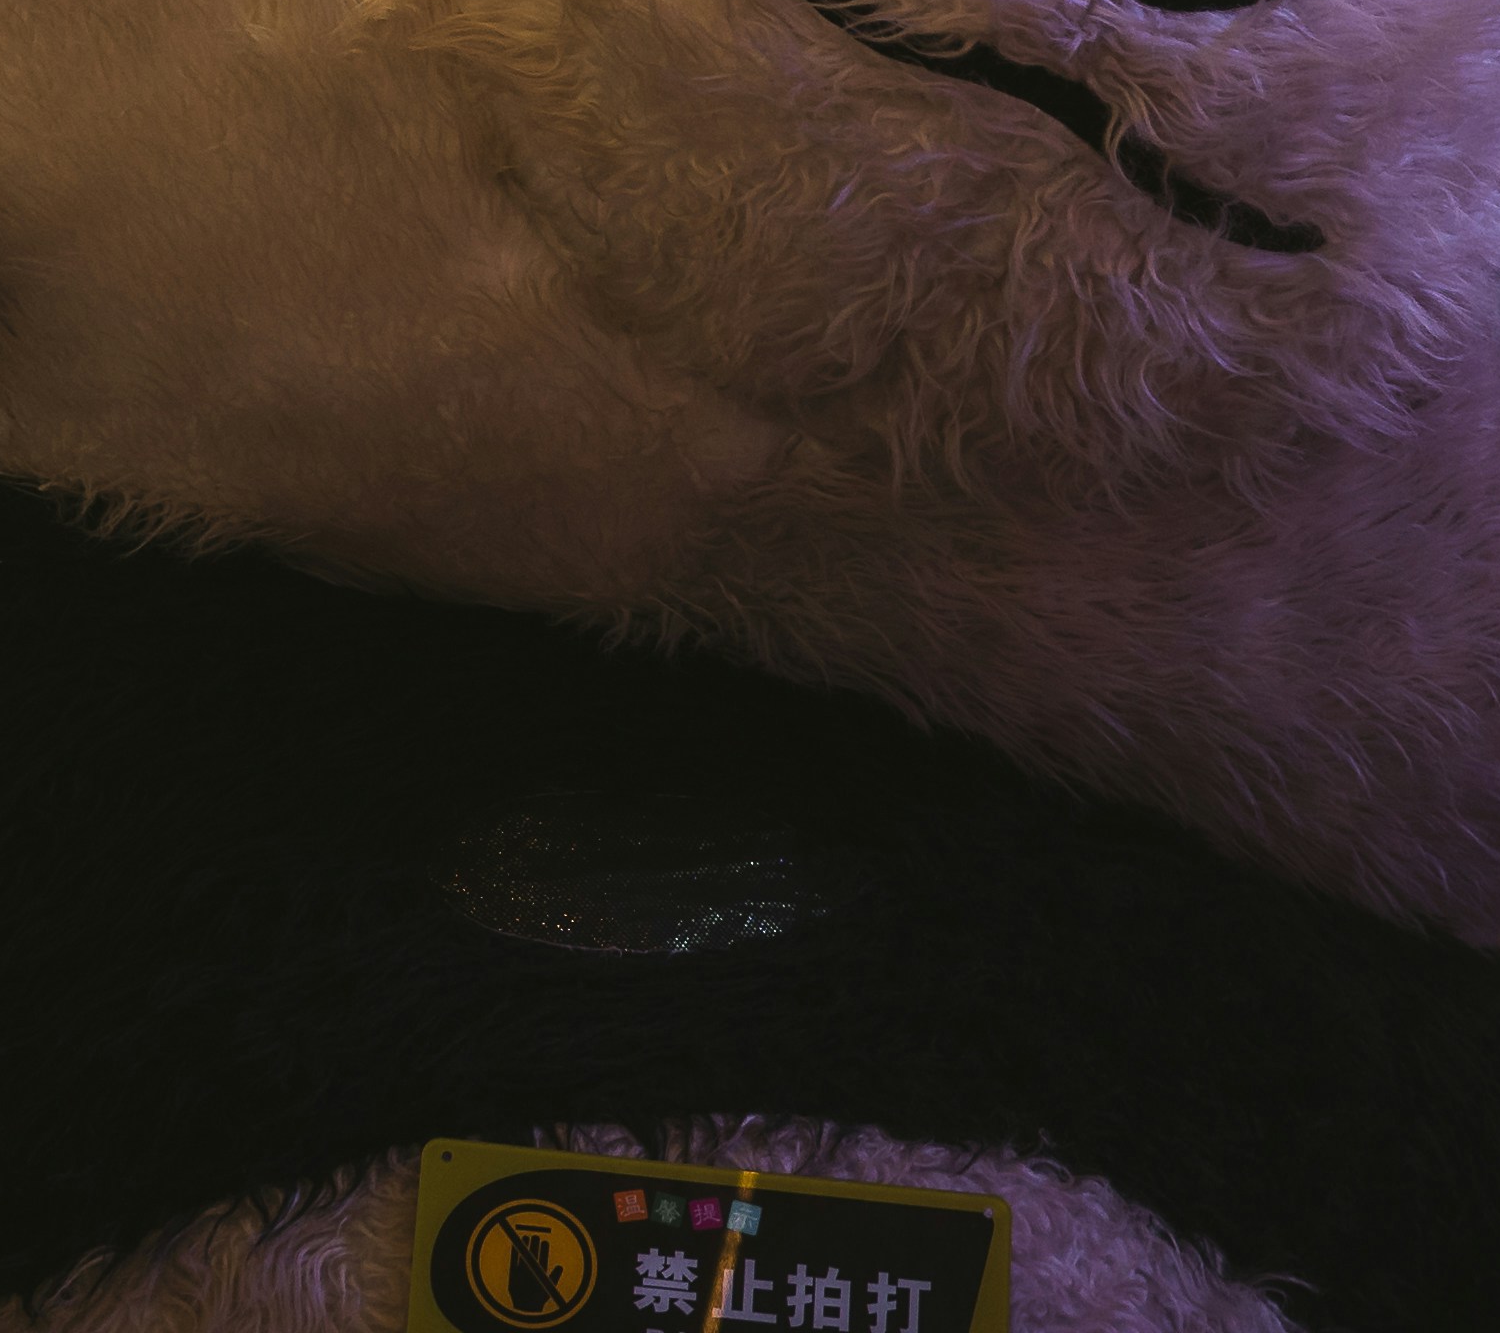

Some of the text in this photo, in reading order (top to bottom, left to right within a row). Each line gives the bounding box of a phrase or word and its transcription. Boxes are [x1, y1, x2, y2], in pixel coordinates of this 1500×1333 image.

[615, 1190, 762, 1233] 温馨提示
[633, 1247, 932, 1333] 禁止拍打
